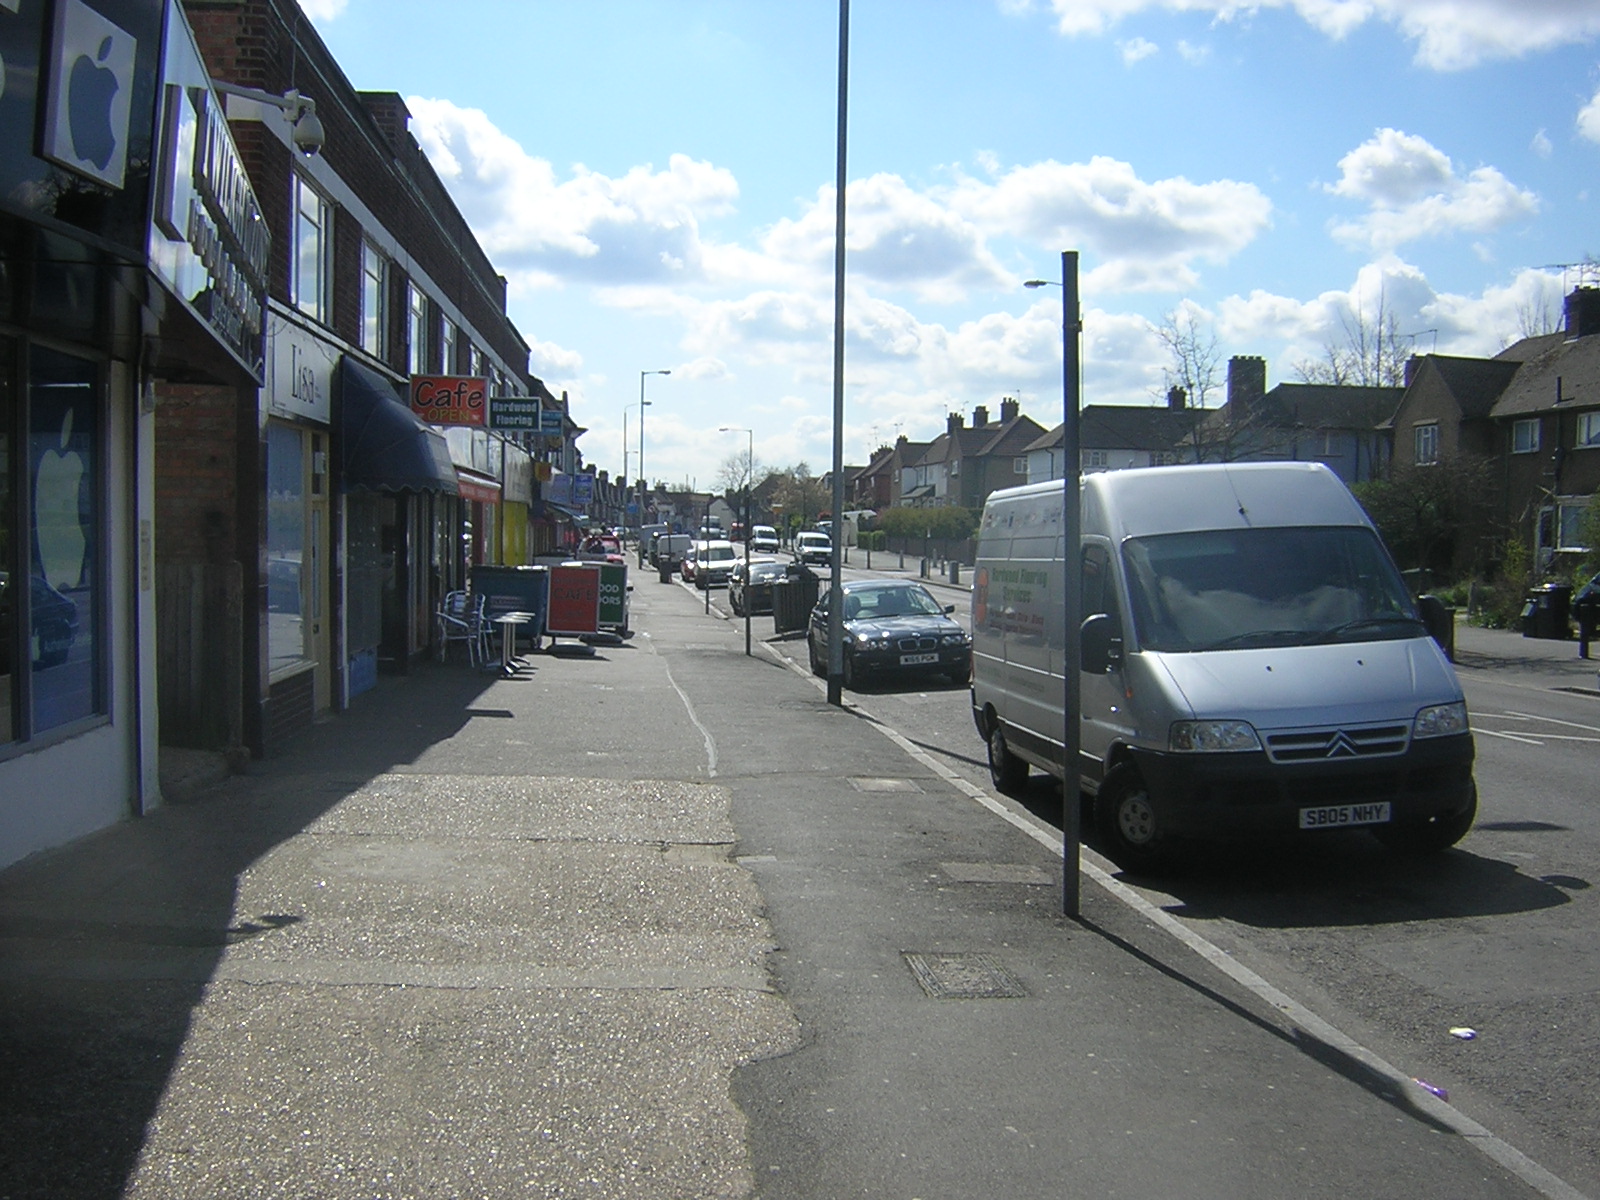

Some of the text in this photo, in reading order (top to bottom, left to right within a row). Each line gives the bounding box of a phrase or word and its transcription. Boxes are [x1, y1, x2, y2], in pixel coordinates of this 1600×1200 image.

[414, 380, 483, 409] Cafe
[492, 402, 537, 412] Hardwood
[428, 408, 470, 421] OPEN
[496, 415, 532, 426] Flooring
[1306, 805, 1383, 825] SB05 NHY
